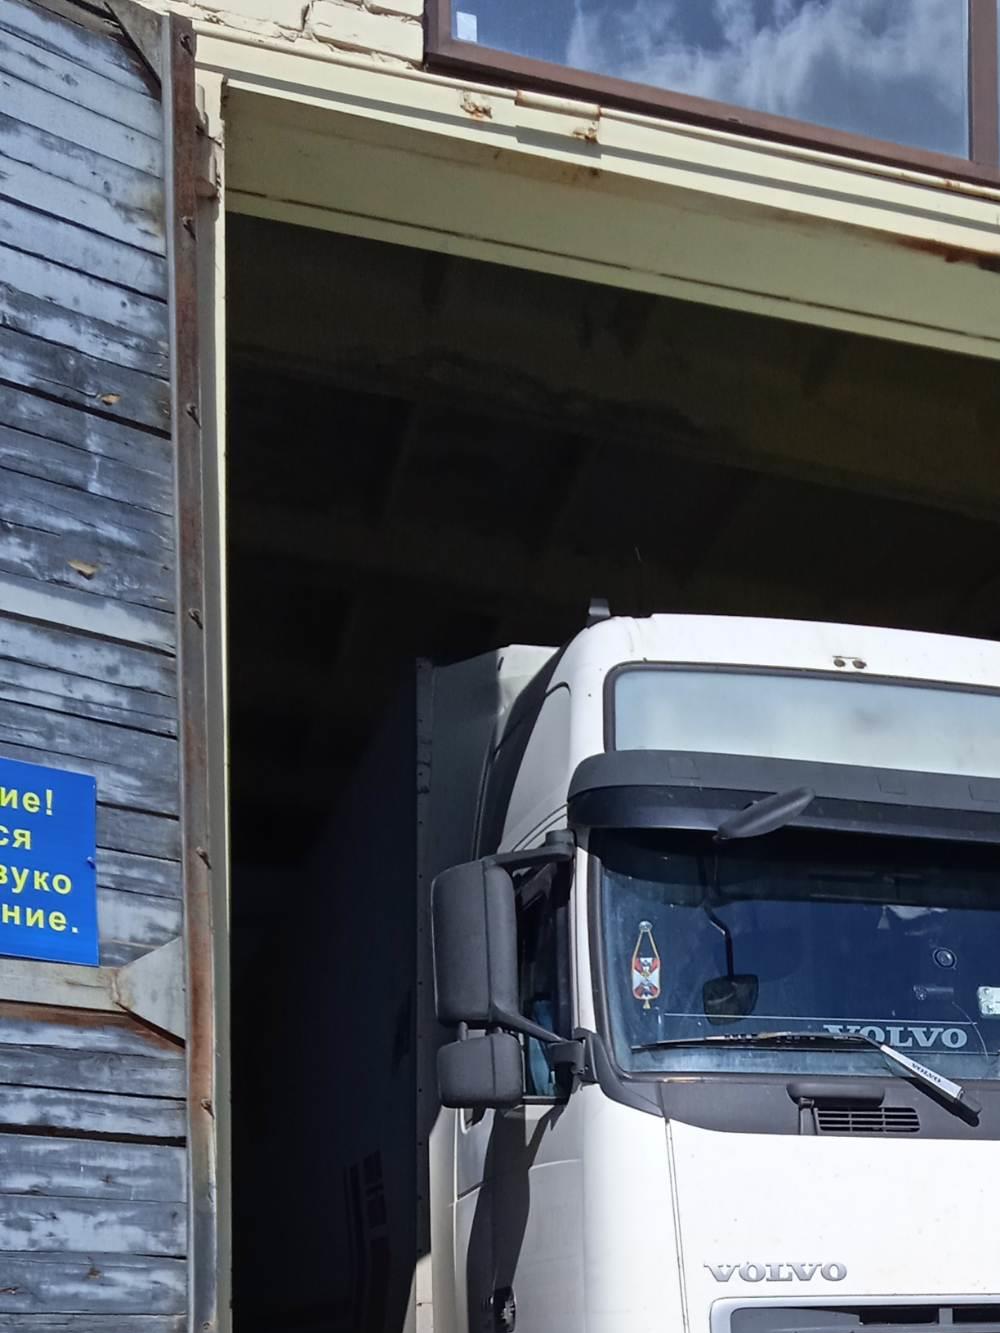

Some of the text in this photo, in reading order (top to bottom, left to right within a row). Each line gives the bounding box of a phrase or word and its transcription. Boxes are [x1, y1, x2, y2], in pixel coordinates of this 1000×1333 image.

[2, 902, 79, 934] ние.
[911, 1062, 943, 1084] VOLVO
[703, 1262, 848, 1283] VOLVO
